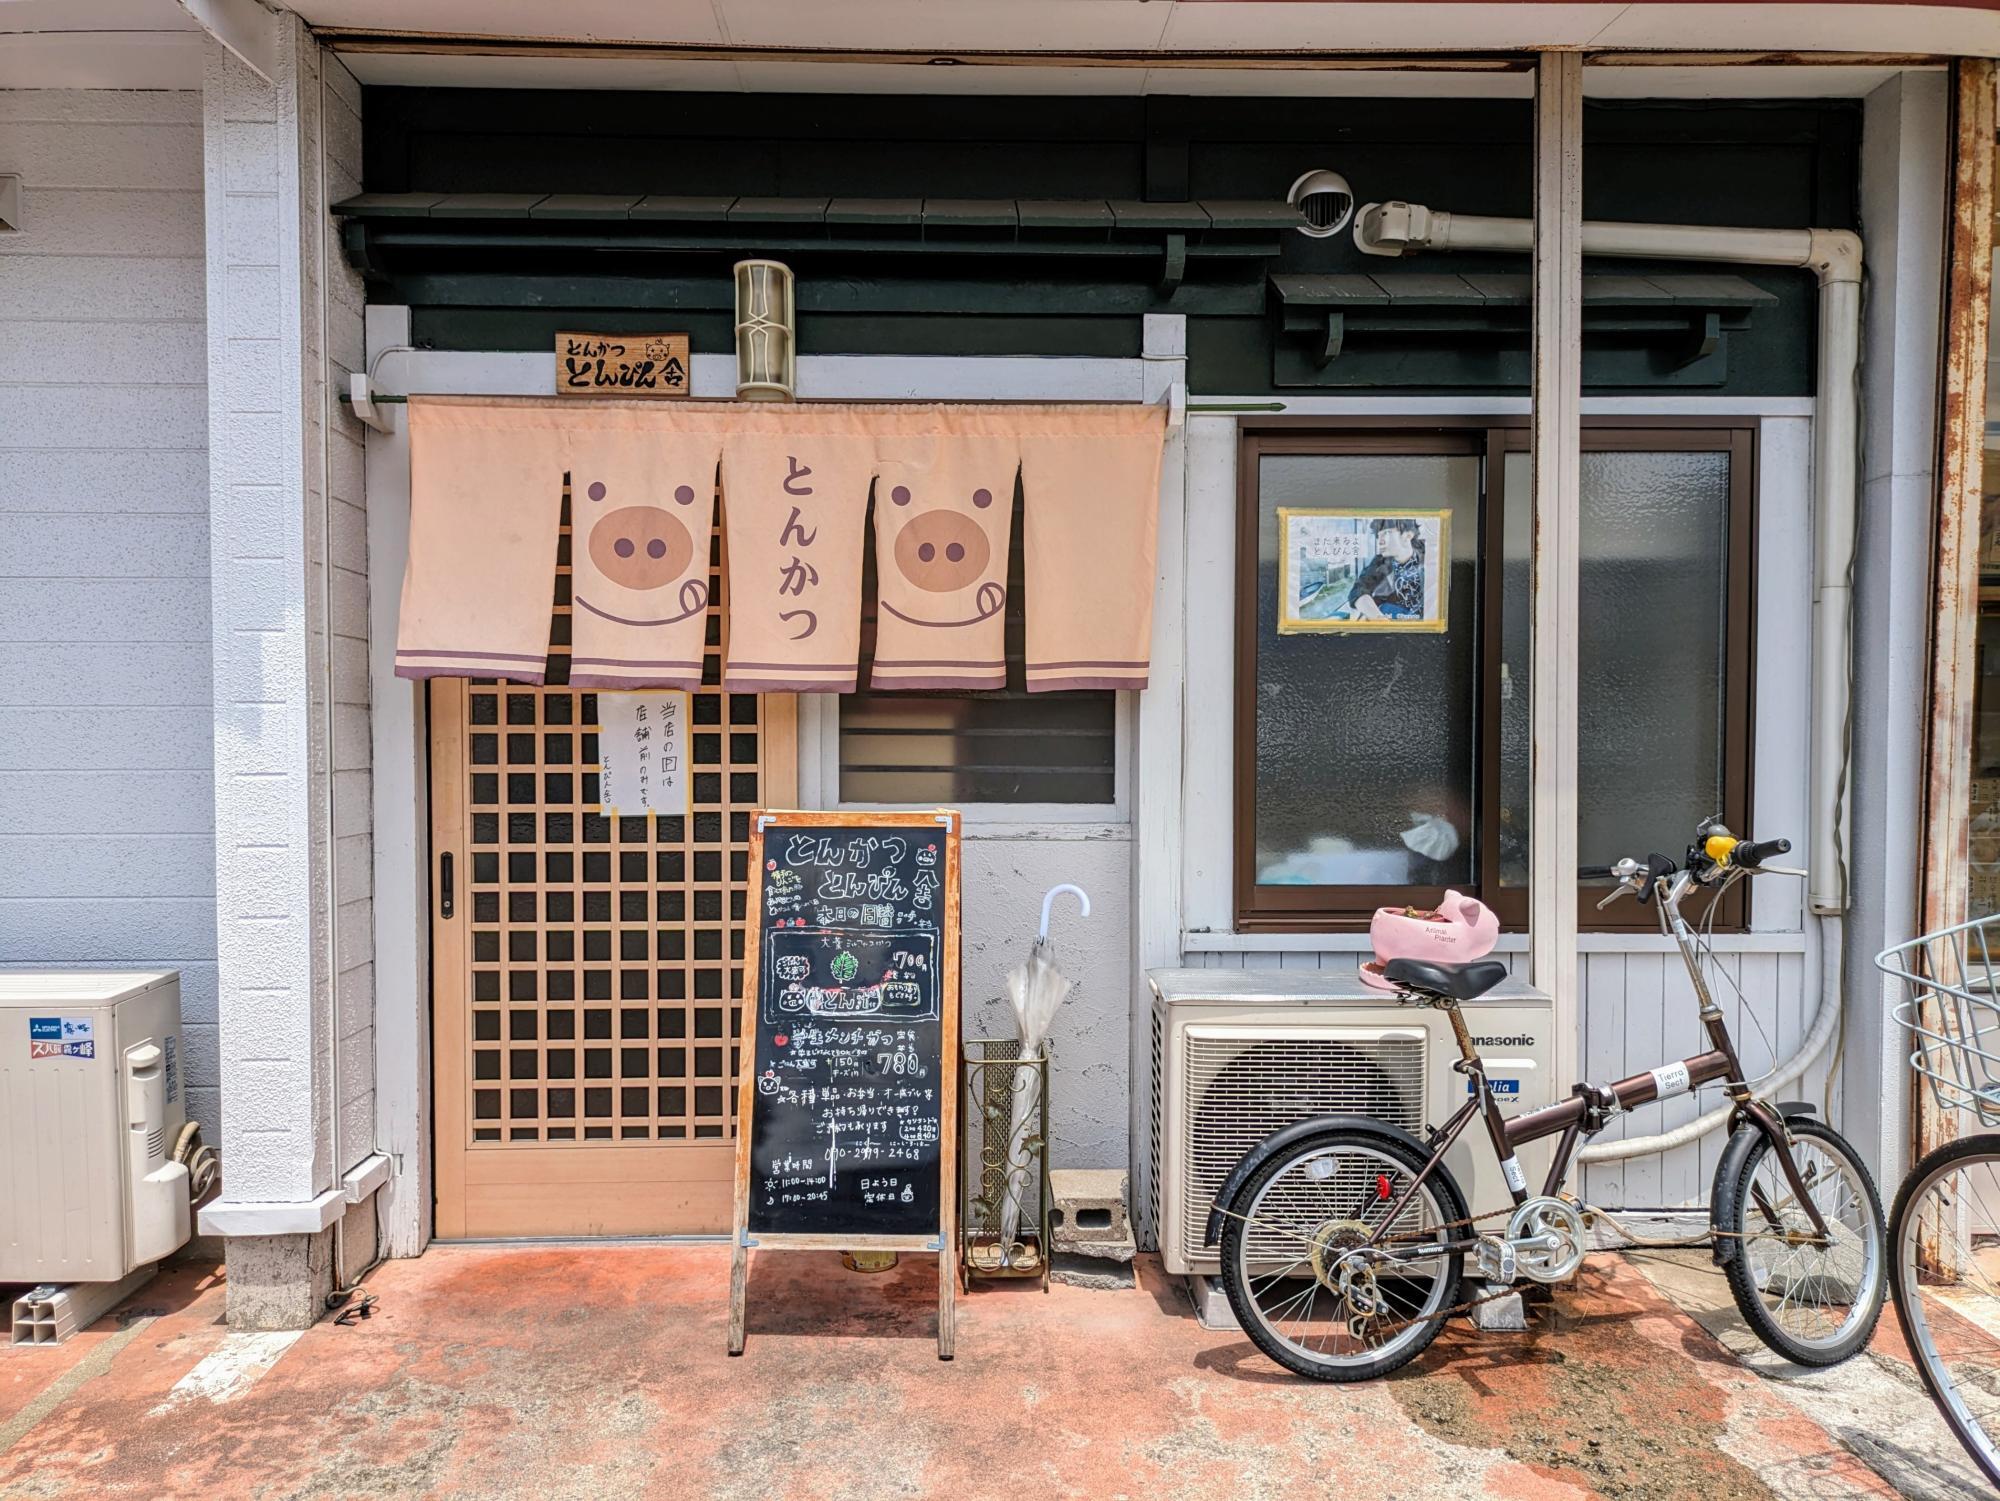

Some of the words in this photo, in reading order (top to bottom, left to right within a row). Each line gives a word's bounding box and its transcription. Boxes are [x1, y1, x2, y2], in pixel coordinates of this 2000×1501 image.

[567, 339, 625, 357] とんかつ
[566, 357, 685, 388] とんぴん舎
[779, 456, 818, 640] とんかつ
[785, 834, 907, 868] とんかつ
[1658, 1070, 1685, 1082] Tierra
[1665, 1079, 1684, 1090] Sect
